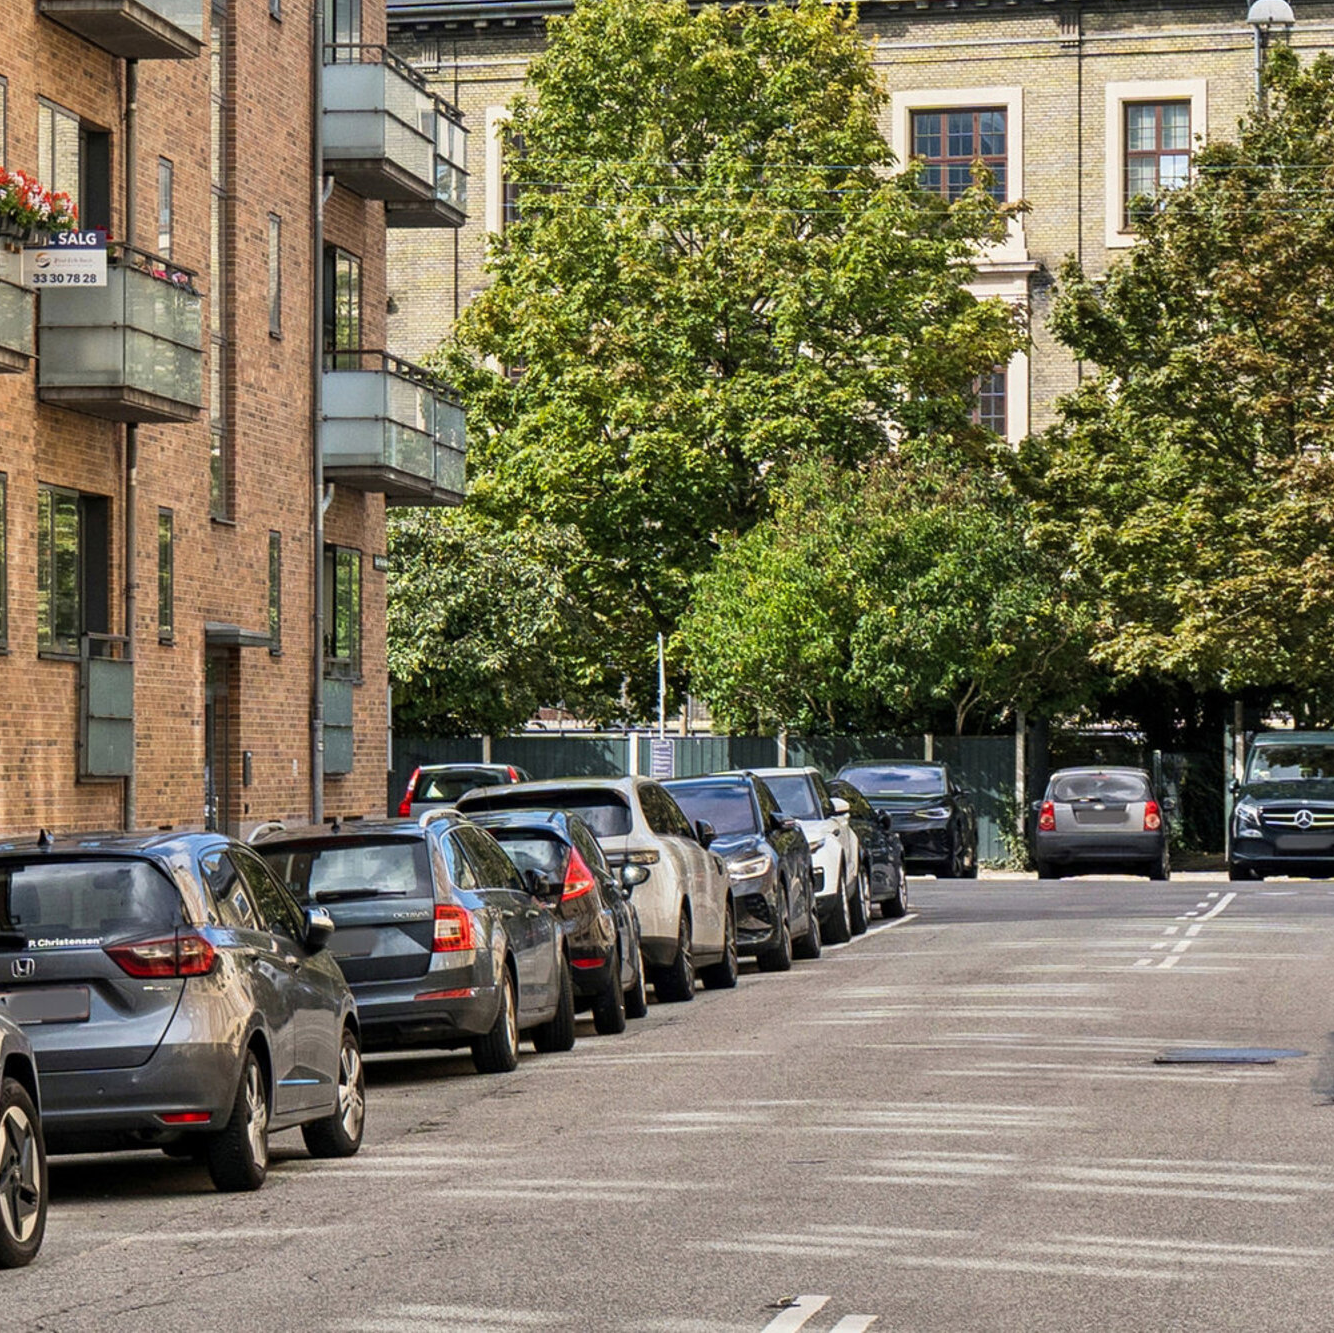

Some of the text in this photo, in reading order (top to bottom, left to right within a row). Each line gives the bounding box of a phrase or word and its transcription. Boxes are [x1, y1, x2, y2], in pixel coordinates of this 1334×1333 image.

[58, 232, 97, 246] SALG
[33, 273, 97, 283] 33 30 78 28
